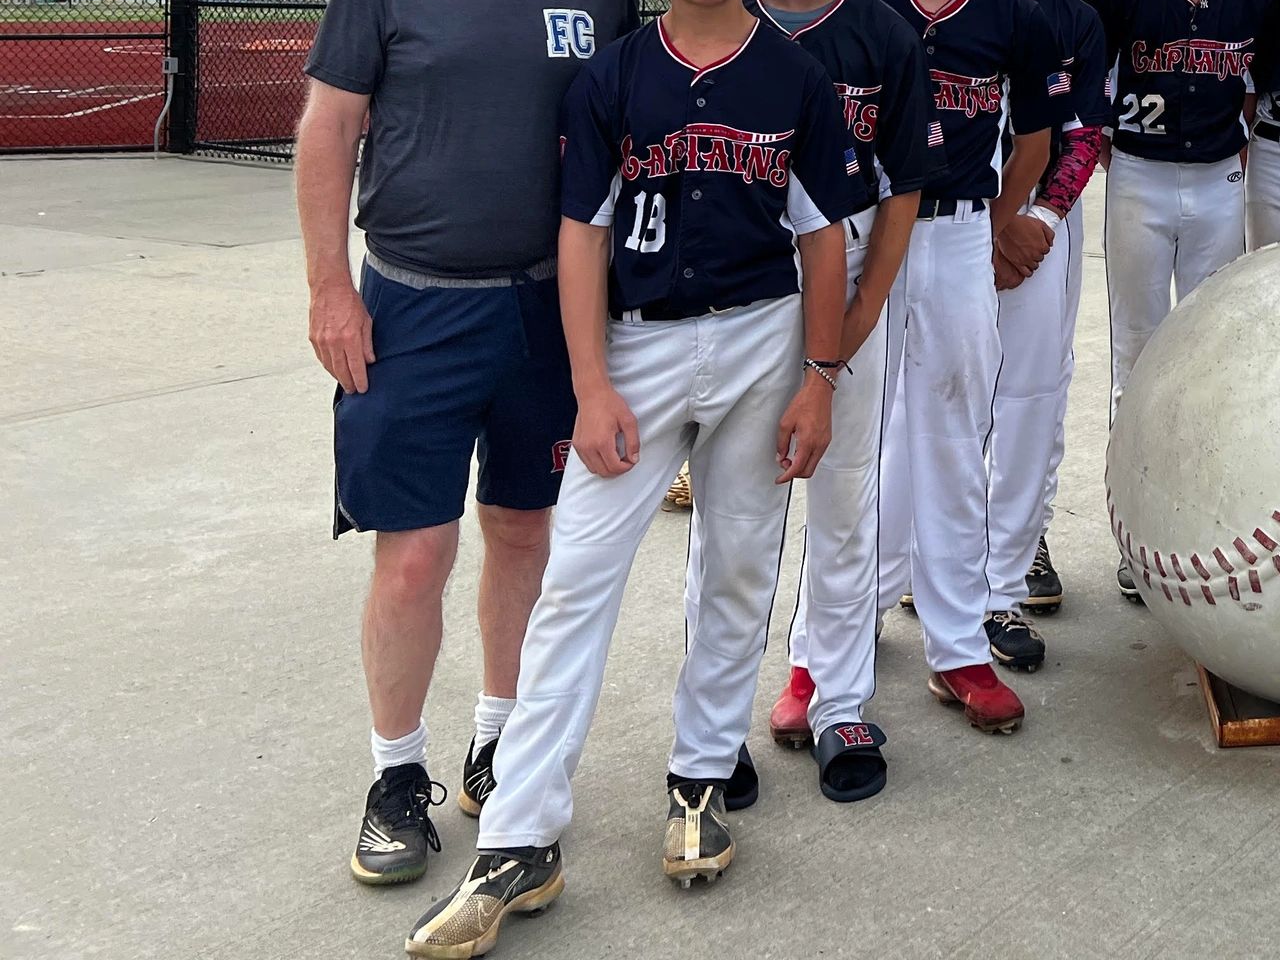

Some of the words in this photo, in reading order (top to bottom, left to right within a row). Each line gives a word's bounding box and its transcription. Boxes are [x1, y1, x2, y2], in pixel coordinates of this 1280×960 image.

[543, 8, 596, 59] FC
[1118, 93, 1167, 134] 22
[621, 126, 793, 188] CAPTAINS
[835, 724, 874, 747] FC
